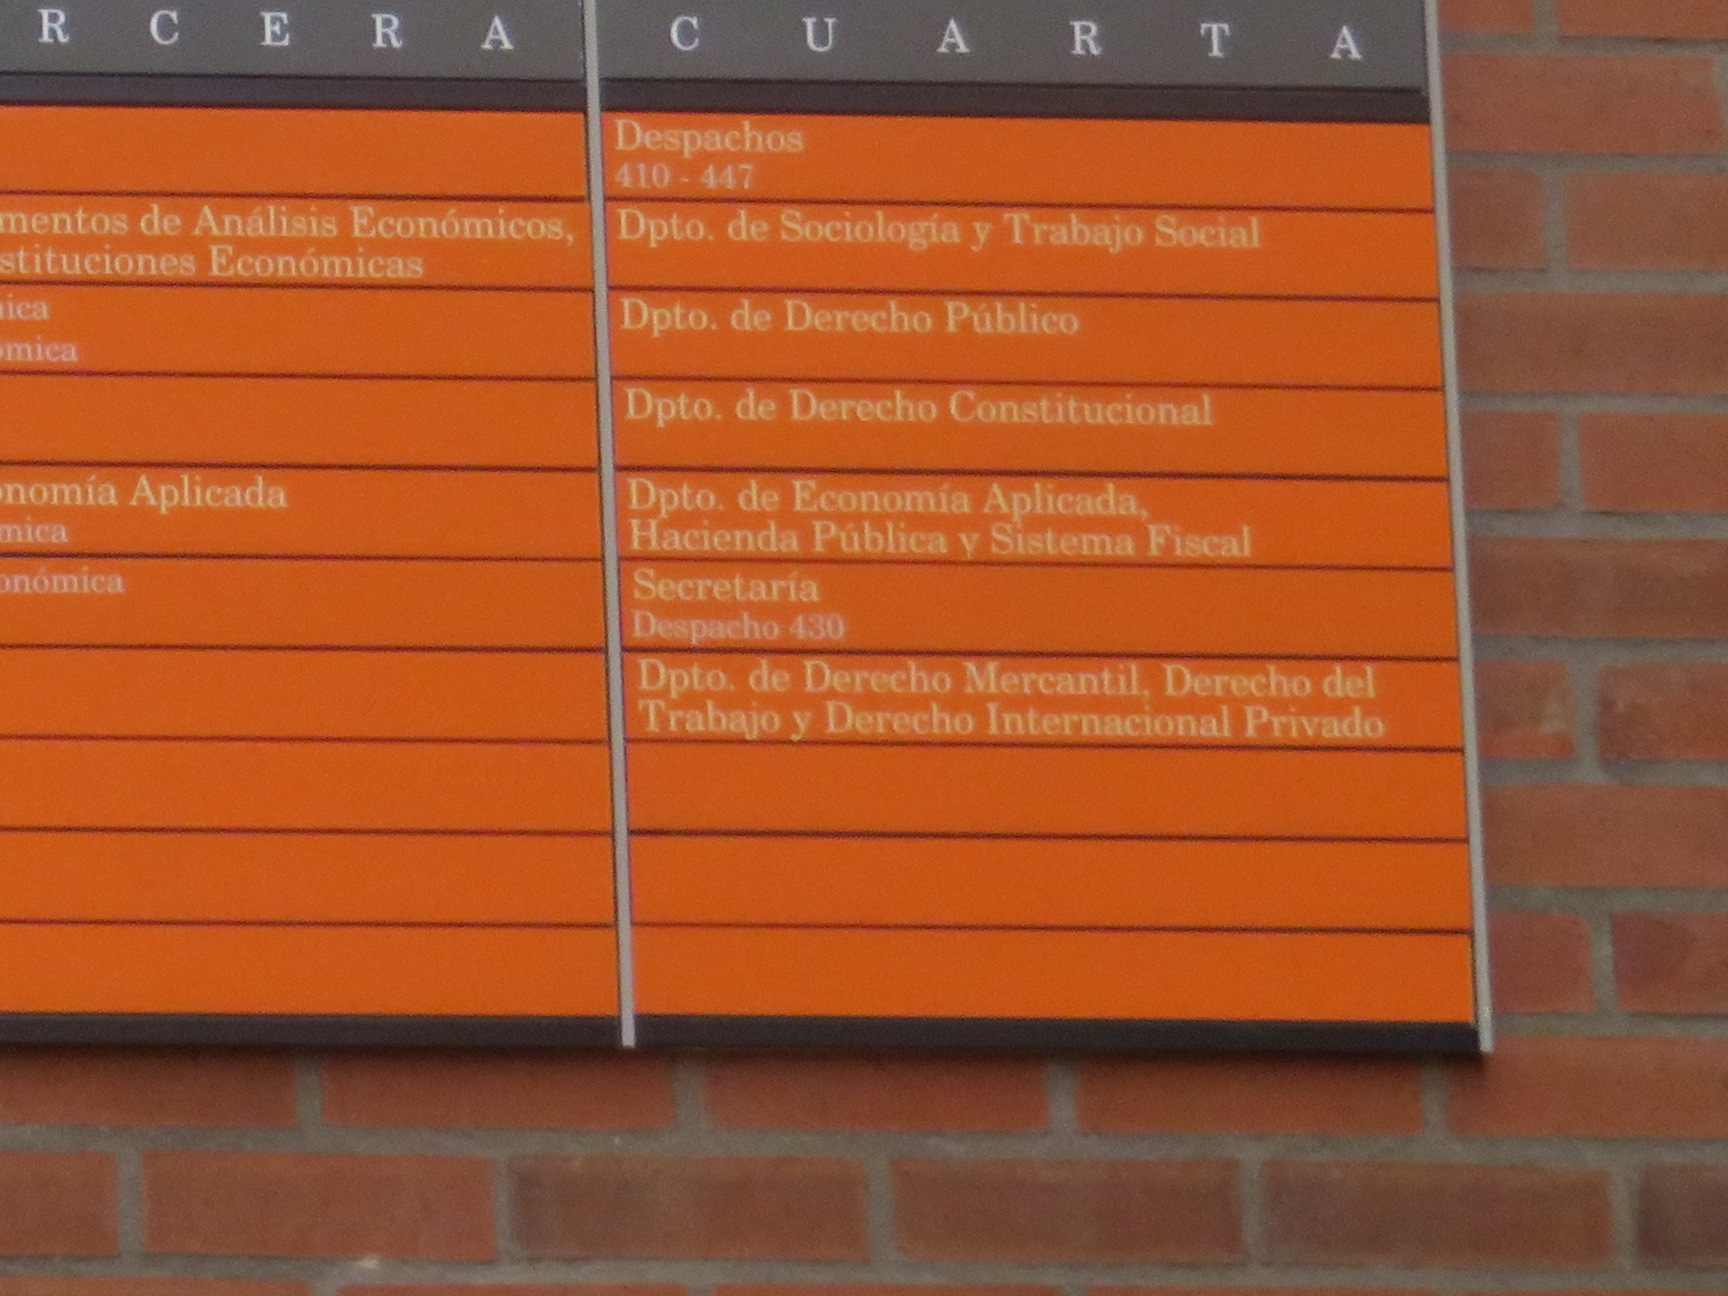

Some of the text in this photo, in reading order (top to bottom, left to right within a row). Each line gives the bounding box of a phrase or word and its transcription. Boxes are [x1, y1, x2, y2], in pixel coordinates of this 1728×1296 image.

[614, 117, 803, 162] Despachos
[139, 202, 182, 236] de
[192, 202, 338, 240] Análisis
[348, 203, 574, 247] Económicos,
[616, 206, 1260, 255] Dpto. de Sociología Trabajo Social
[208, 242, 424, 279] Económicas
[619, 295, 1080, 340] Dpto. de Derecho Público
[623, 387, 1212, 430] Dpto. de Derecho Constitucional
[129, 471, 287, 516] Aplicada
[627, 477, 1148, 522] Dpto. de Economía Aplicada,
[630, 518, 1252, 558] Hacienda Pública Sistema Fiscal
[632, 567, 821, 603] Secretaría
[637, 657, 1375, 704] Dpto. de Derecho Mercantil, Derecho del
[641, 699, 1384, 742] Trabajo Derecho Internacional Privado
